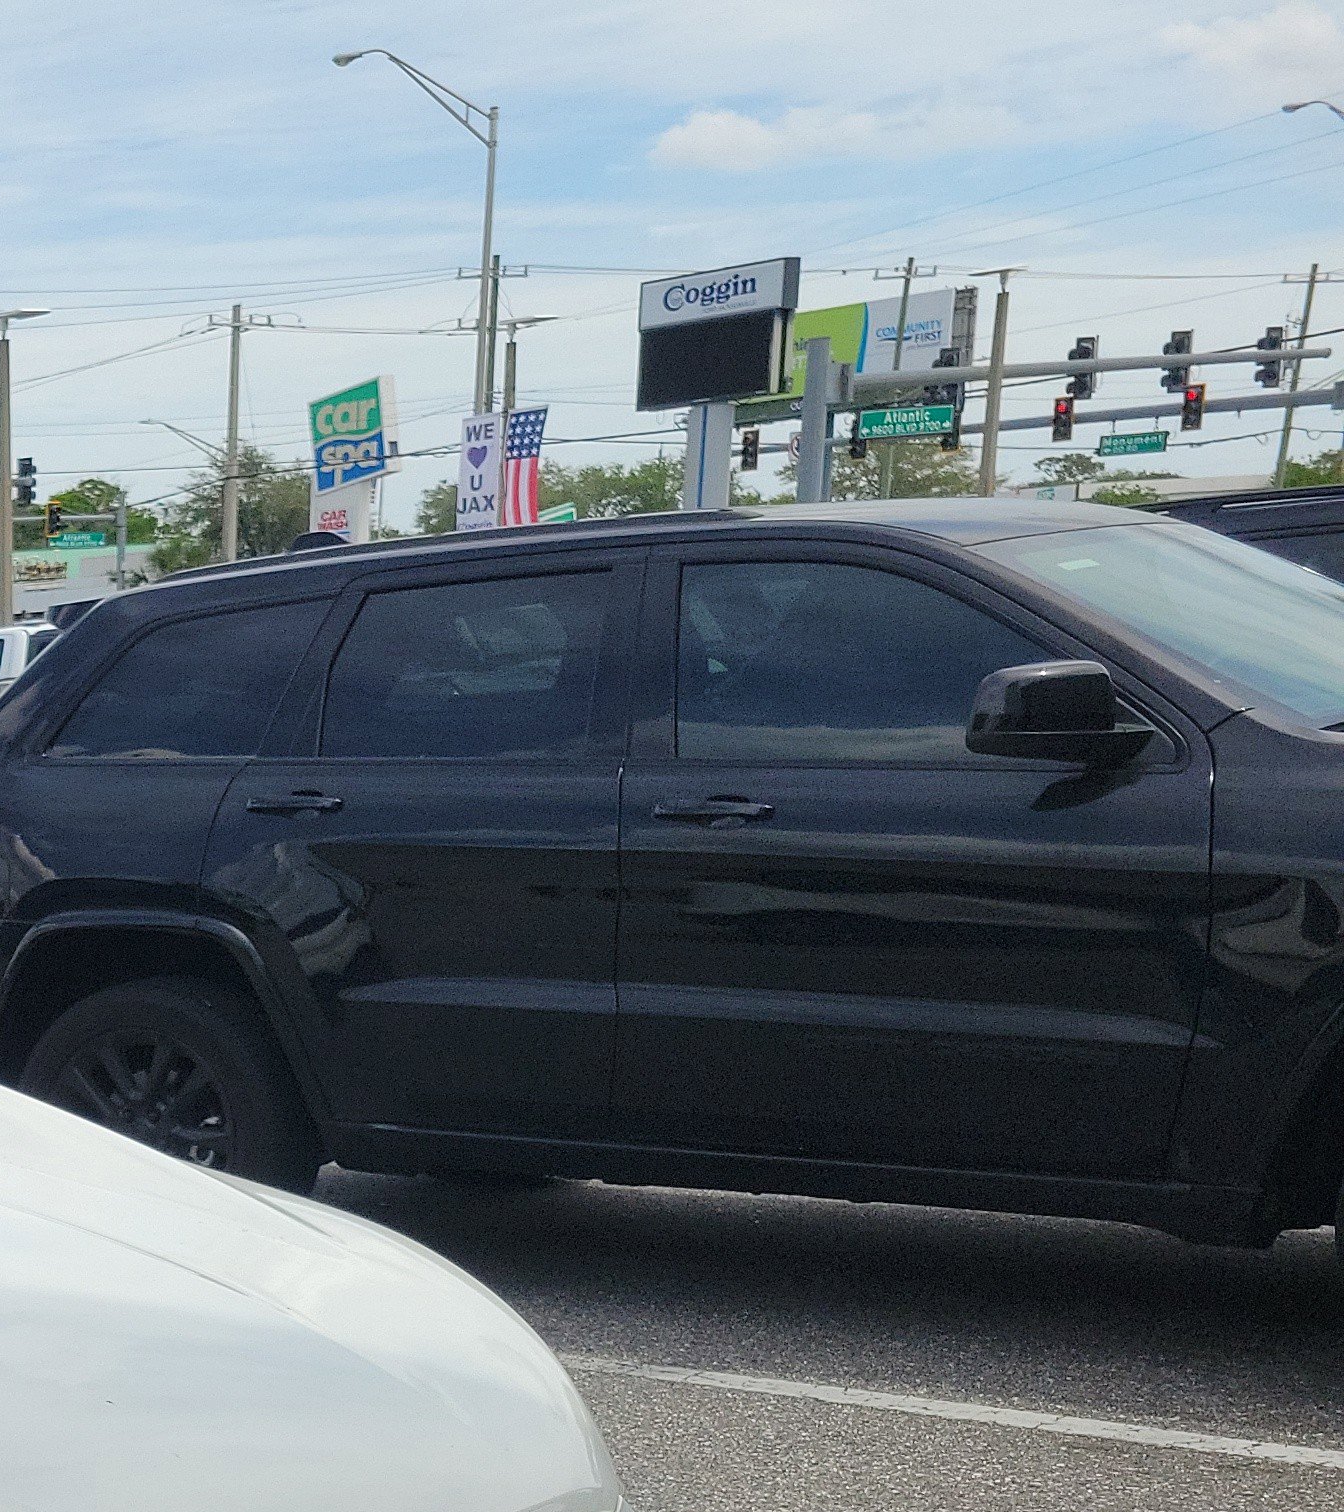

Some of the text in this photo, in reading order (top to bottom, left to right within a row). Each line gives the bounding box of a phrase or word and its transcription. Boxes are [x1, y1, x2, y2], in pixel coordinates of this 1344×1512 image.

[663, 274, 756, 311] Coggin
[914, 330, 941, 342] FIRST
[316, 399, 375, 434] car
[884, 409, 930, 424] Atlantic
[466, 422, 494, 442] WE
[1103, 434, 1163, 446] Monument
[320, 442, 377, 483] spa
[470, 474, 482, 491] U
[457, 495, 494, 514] JAX
